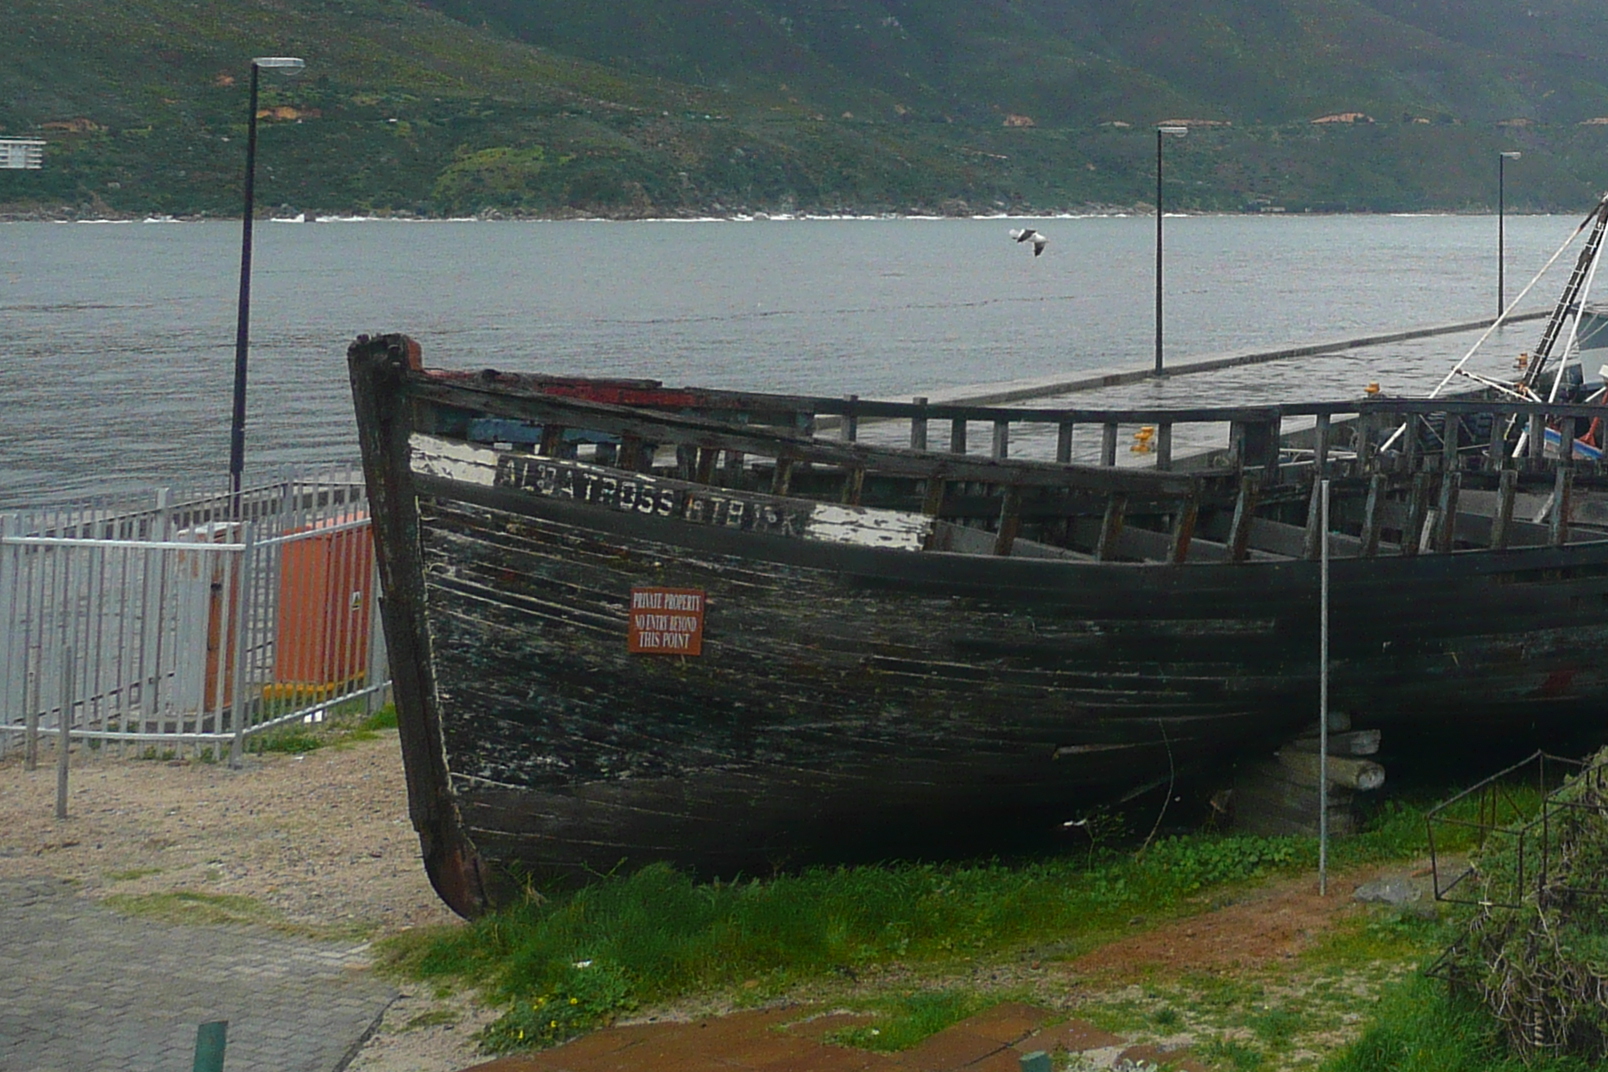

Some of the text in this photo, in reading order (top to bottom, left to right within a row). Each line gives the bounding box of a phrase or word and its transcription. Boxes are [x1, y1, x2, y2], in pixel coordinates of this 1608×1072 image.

[634, 592, 701, 611] PRIVATE PROPERTY
[635, 614, 697, 632] NO ENTRY BEYOND
[639, 631, 690, 648] THIS POINT
